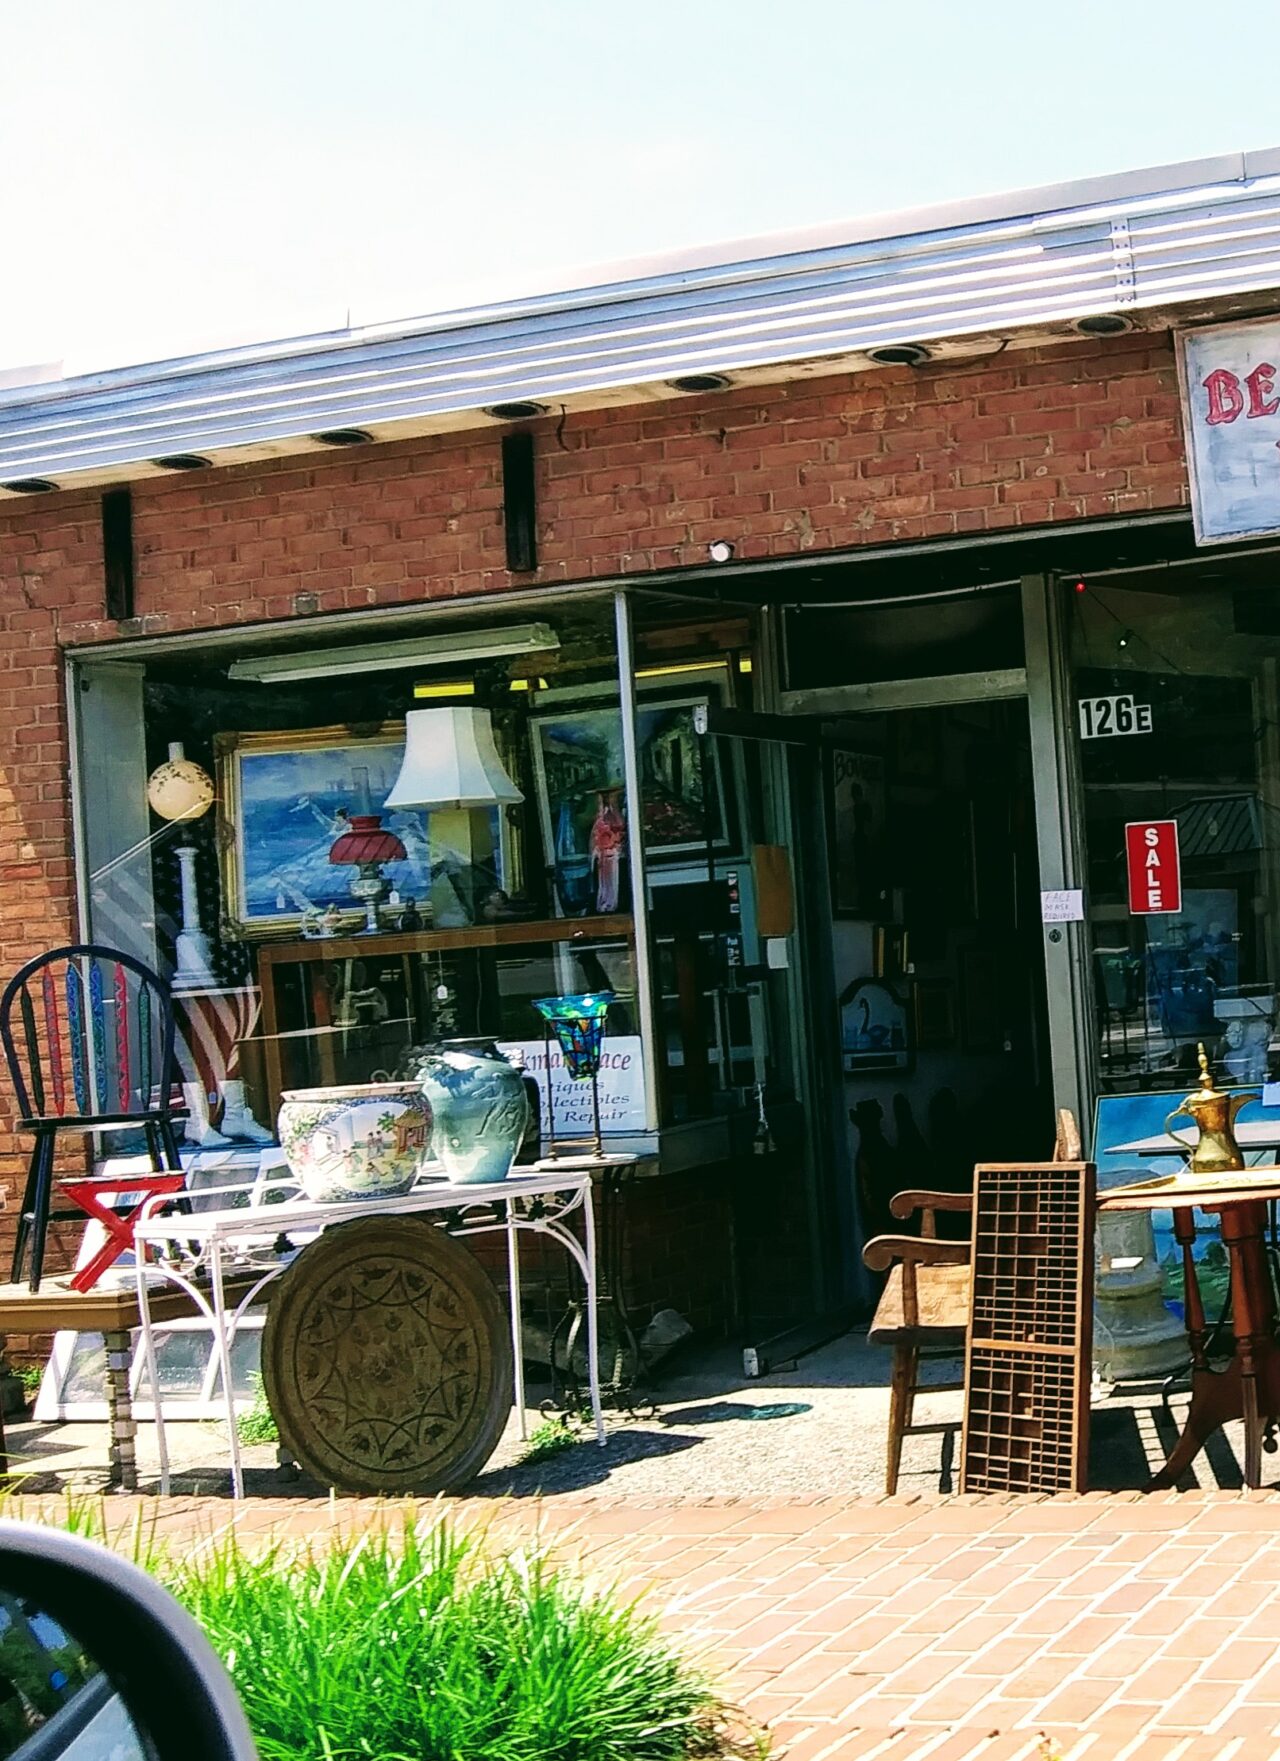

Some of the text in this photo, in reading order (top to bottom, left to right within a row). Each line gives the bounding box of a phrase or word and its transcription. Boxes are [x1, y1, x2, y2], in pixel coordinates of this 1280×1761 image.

[1081, 697, 1151, 737] 126E
[1145, 827, 1162, 908] SALE
[600, 1052, 631, 1070] ace
[540, 1081, 604, 1095] iques
[540, 1093, 630, 1108] olectiles
